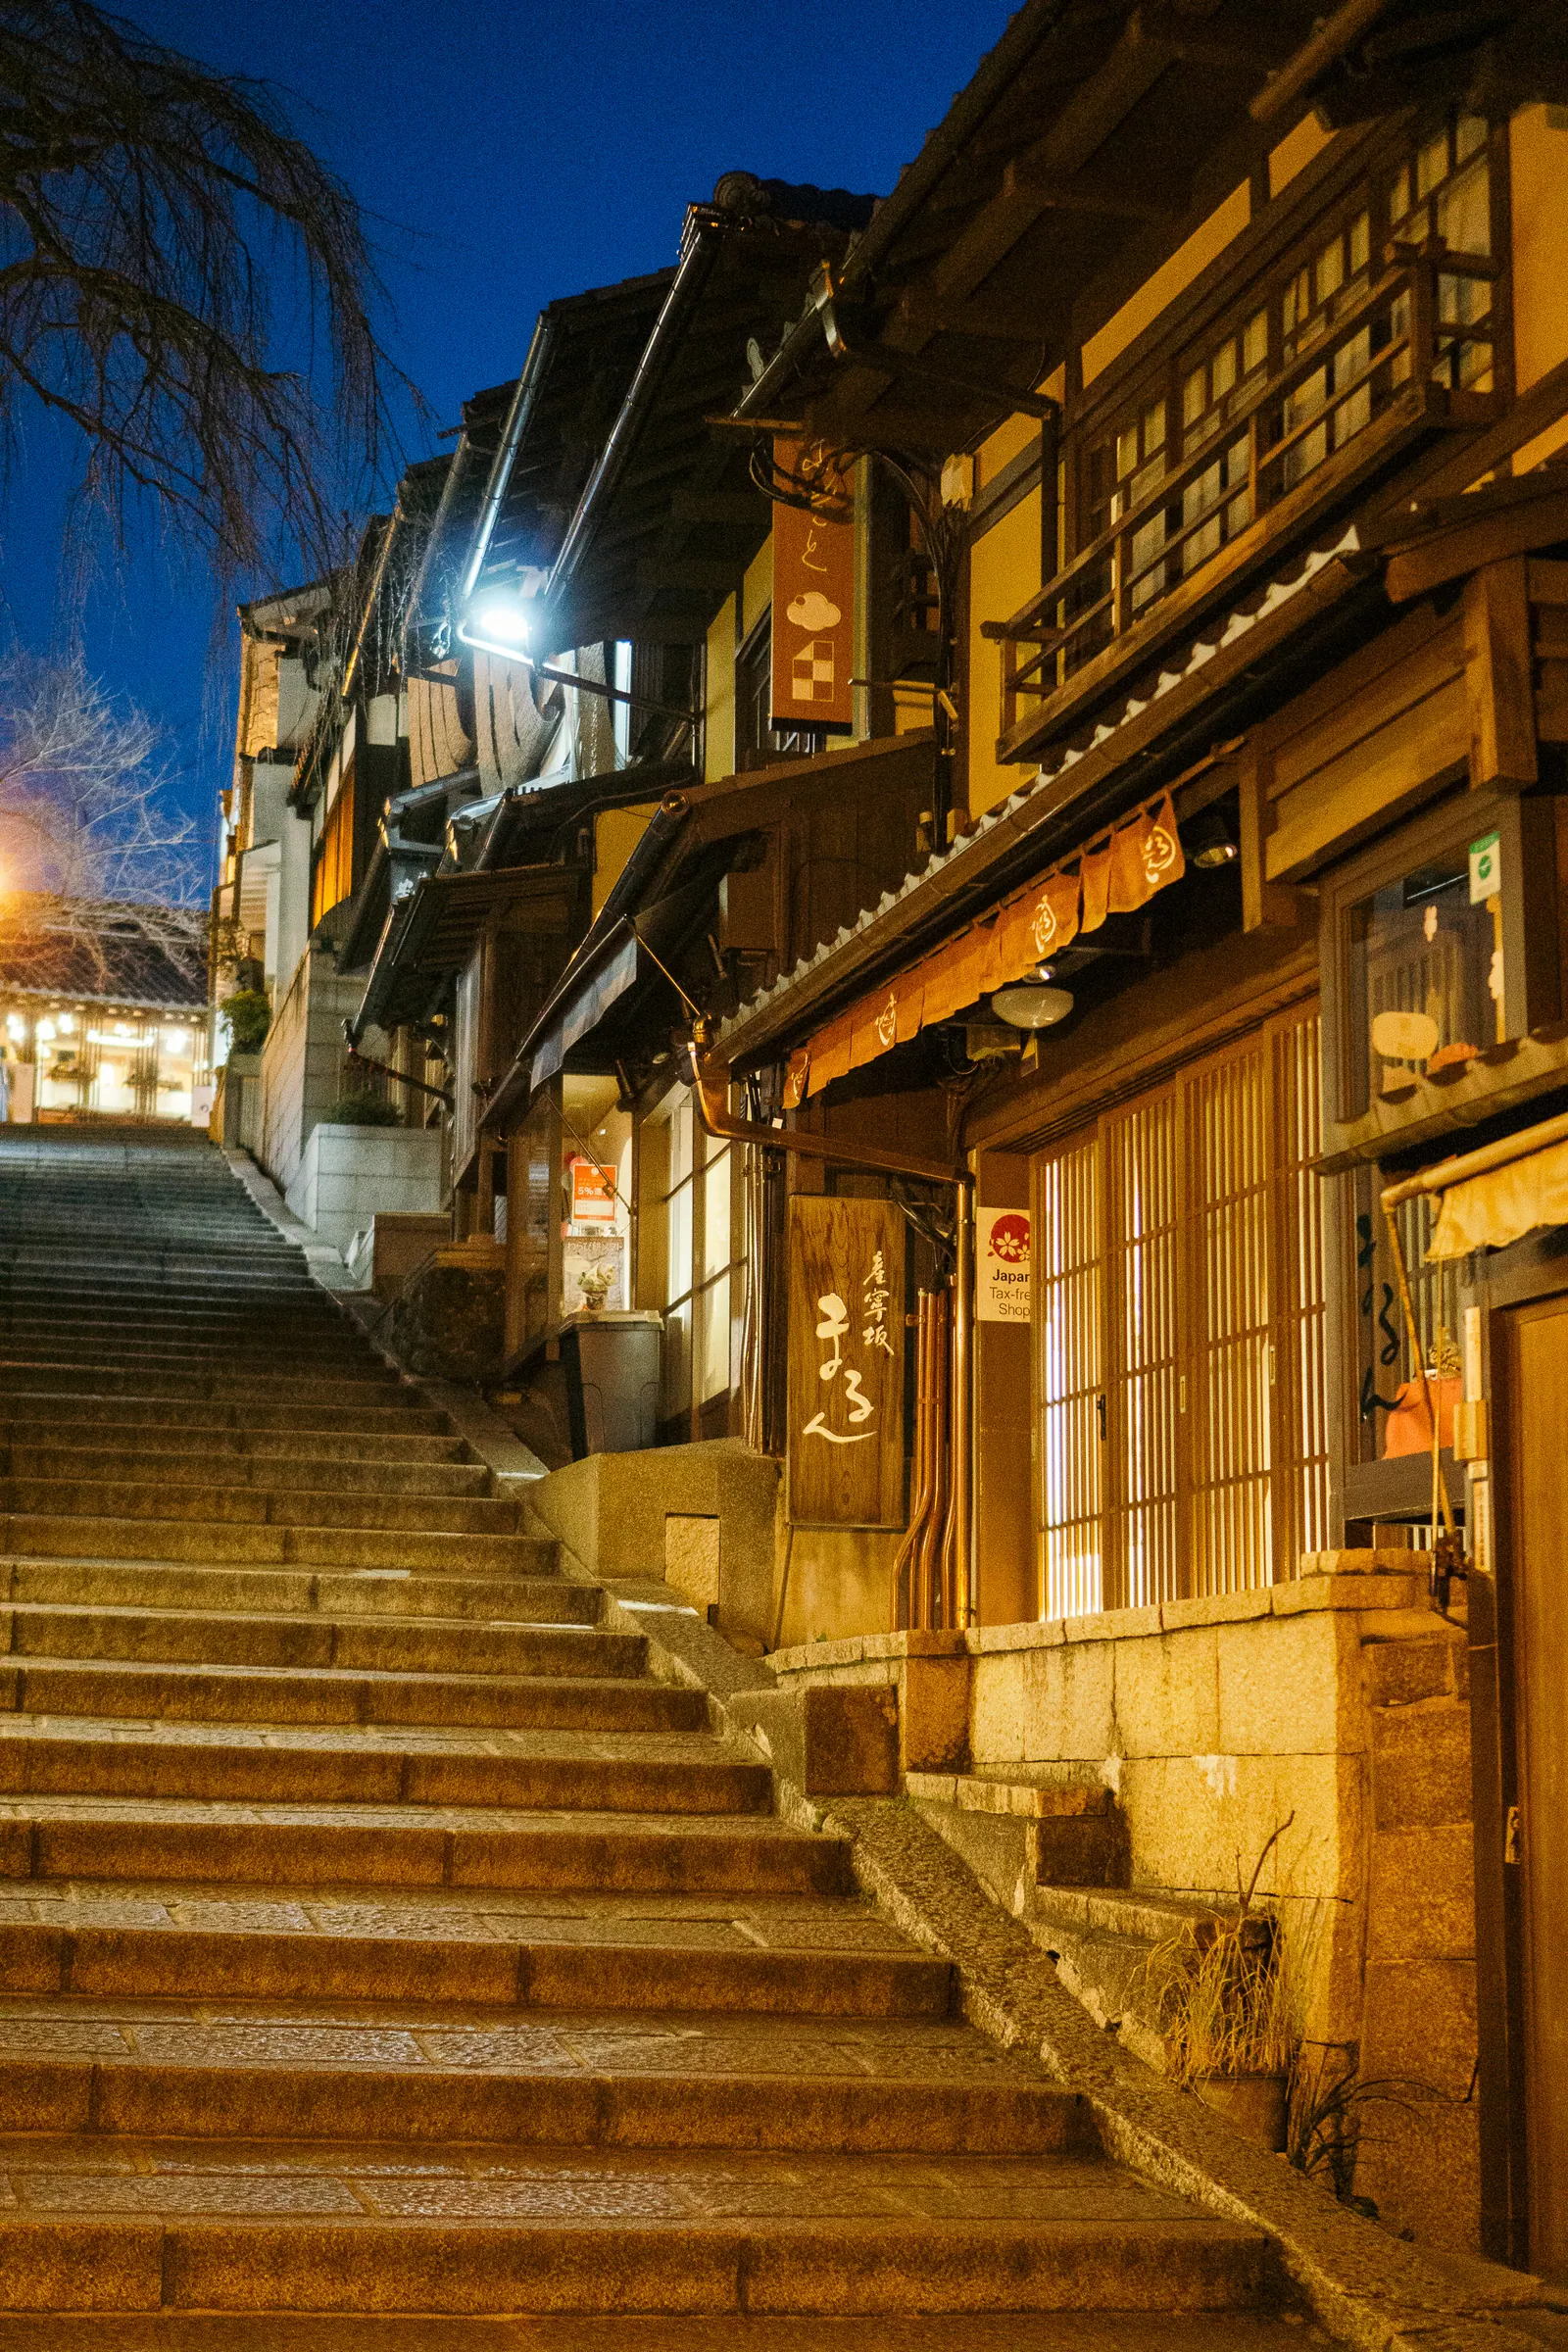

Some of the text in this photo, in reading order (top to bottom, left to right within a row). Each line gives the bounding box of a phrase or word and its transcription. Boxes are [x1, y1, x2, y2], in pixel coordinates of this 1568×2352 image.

[989, 1286, 1030, 1301] Tax-fre
[863, 1250, 895, 1355] 産寧坂
[999, 1302, 1030, 1319] Shop
